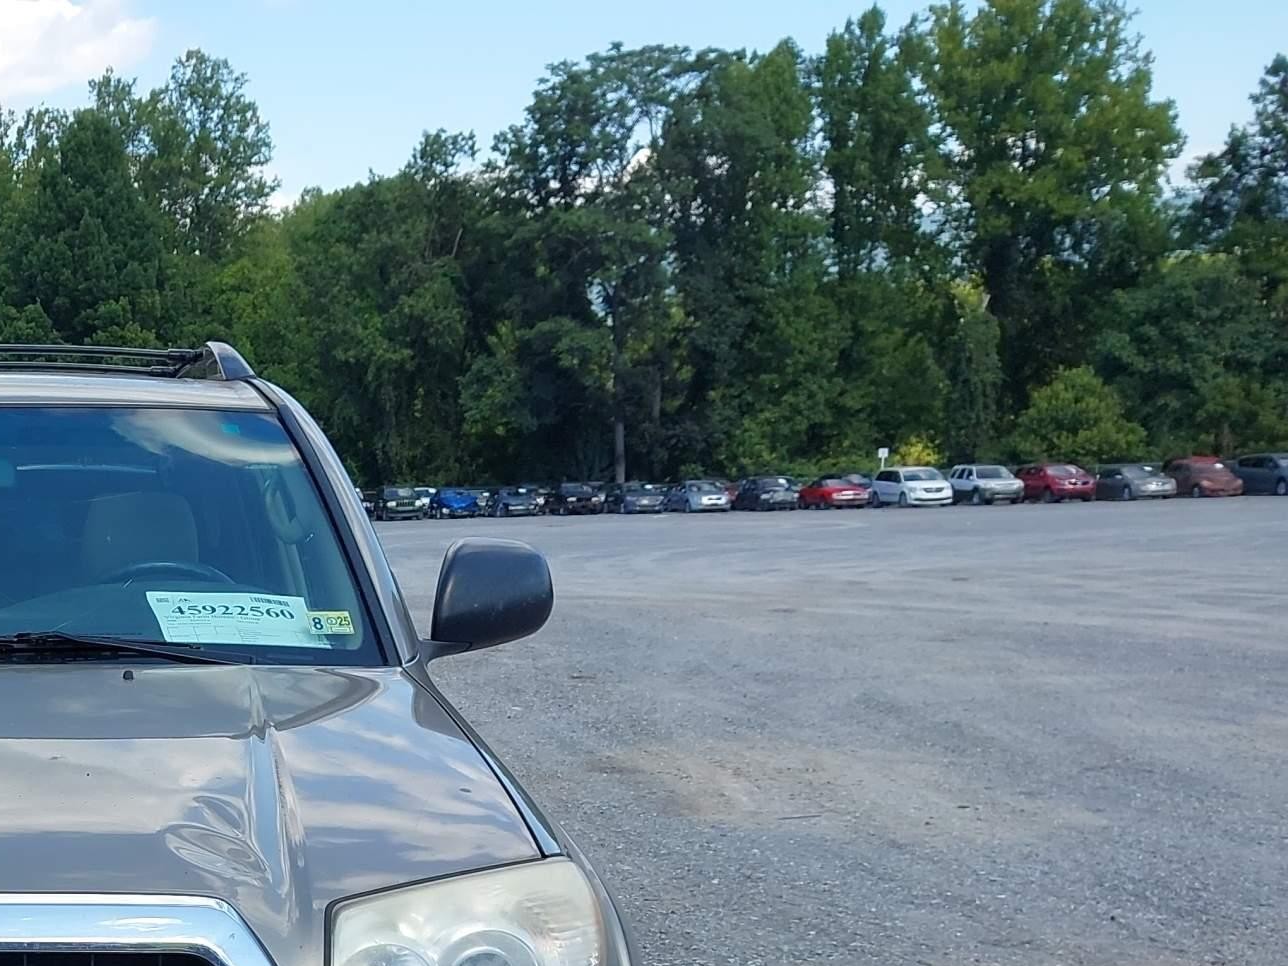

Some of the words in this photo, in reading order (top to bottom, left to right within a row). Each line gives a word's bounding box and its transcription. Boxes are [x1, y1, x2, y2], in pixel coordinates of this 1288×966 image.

[171, 605, 295, 620] 45922560
[312, 616, 324, 630] 8
[337, 616, 350, 626] 25
